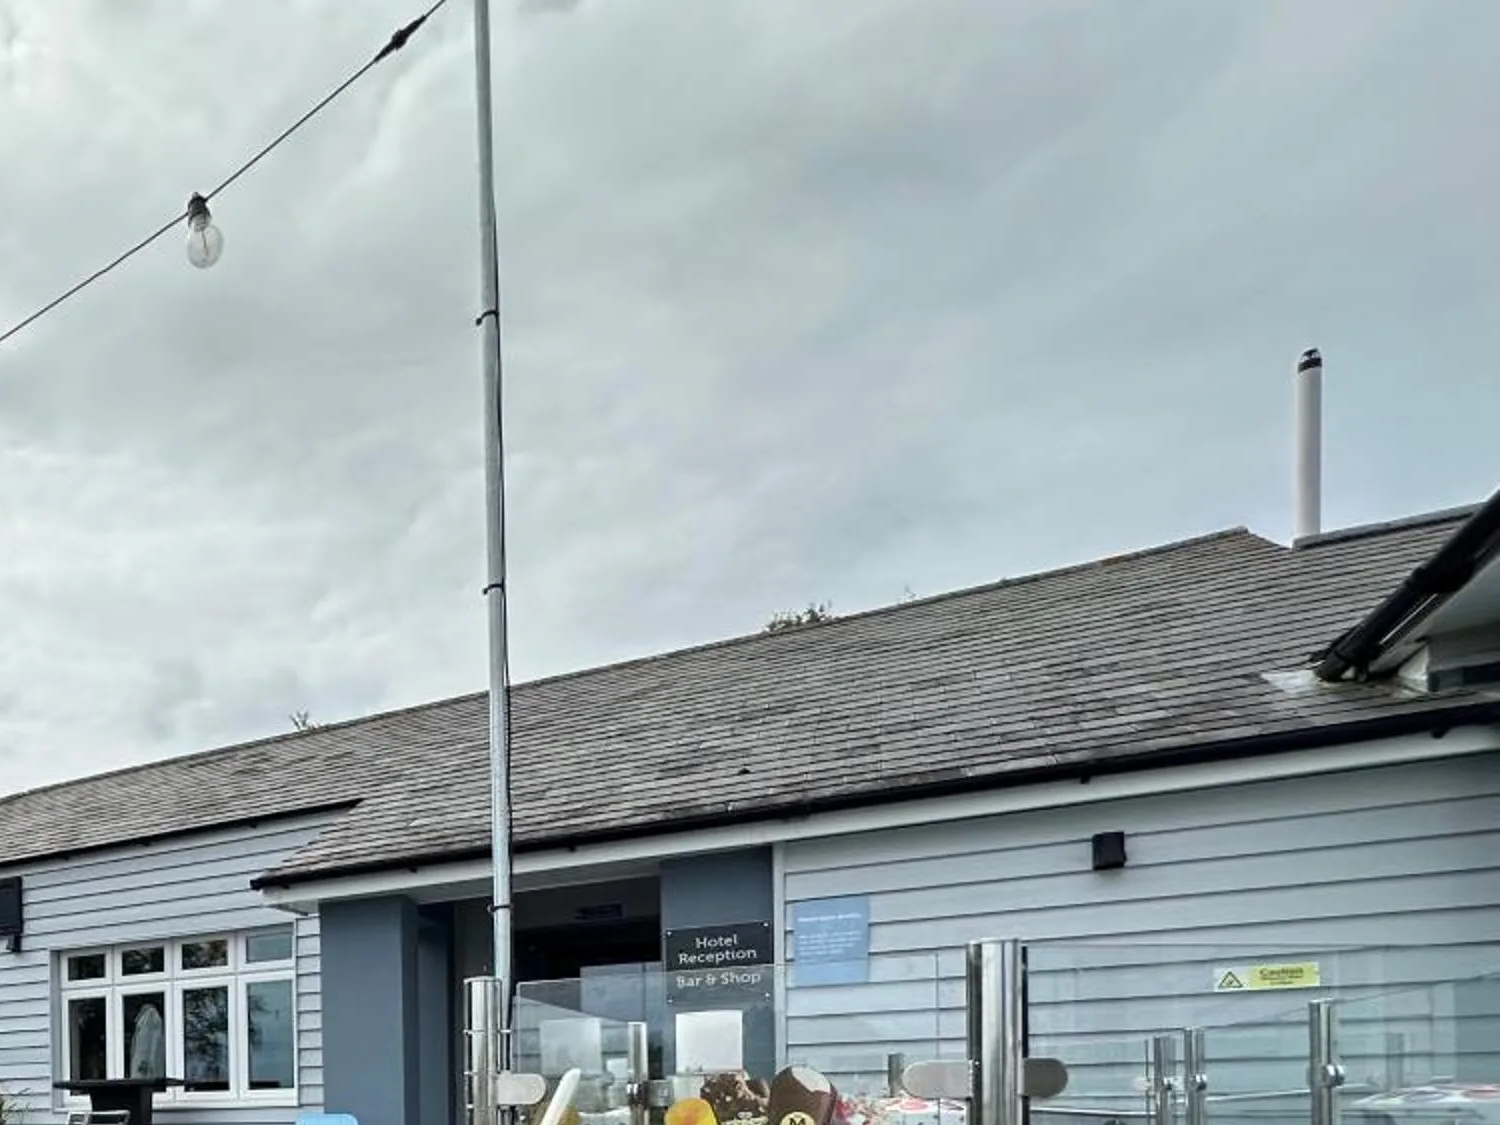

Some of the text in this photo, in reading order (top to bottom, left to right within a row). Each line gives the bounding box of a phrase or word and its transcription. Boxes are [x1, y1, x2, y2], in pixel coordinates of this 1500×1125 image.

[695, 933, 738, 949] Hotel
[678, 948, 757, 965] Reception
[676, 971, 761, 988] Bar & Shop
